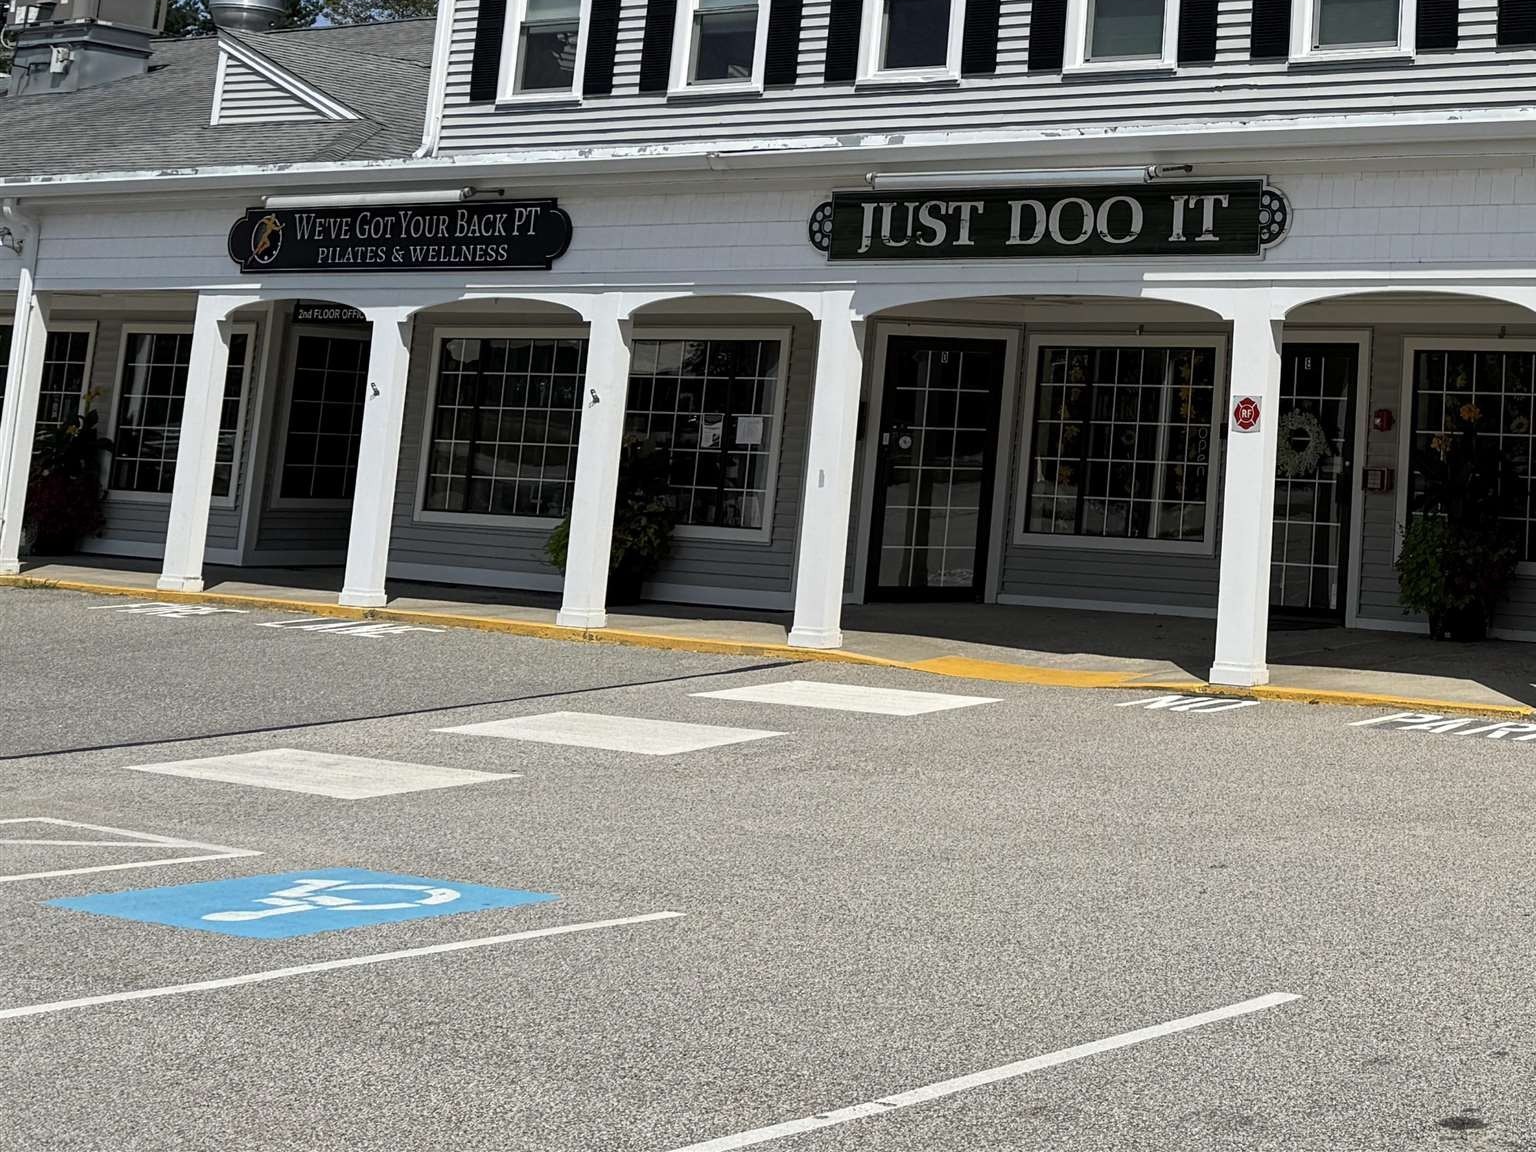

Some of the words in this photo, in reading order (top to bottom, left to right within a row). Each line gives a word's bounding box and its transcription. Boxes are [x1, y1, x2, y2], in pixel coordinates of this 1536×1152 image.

[294, 212, 351, 241] WE'VE
[355, 212, 395, 239] GOT
[399, 210, 449, 238] YOUR
[456, 208, 507, 237] BACK
[512, 207, 541, 236] PT
[857, 200, 985, 254] JUST
[1005, 195, 1144, 246] DOO
[1167, 193, 1230, 242] IT
[316, 247, 387, 264] PILATES
[391, 247, 404, 263] &
[409, 244, 509, 263] WELLNESS
[298, 309, 312, 319] 2nd
[313, 308, 340, 319] FLOOR
[1241, 408, 1252, 419] RF
[255, 617, 446, 638] LANE
[1114, 694, 1261, 714] NO
